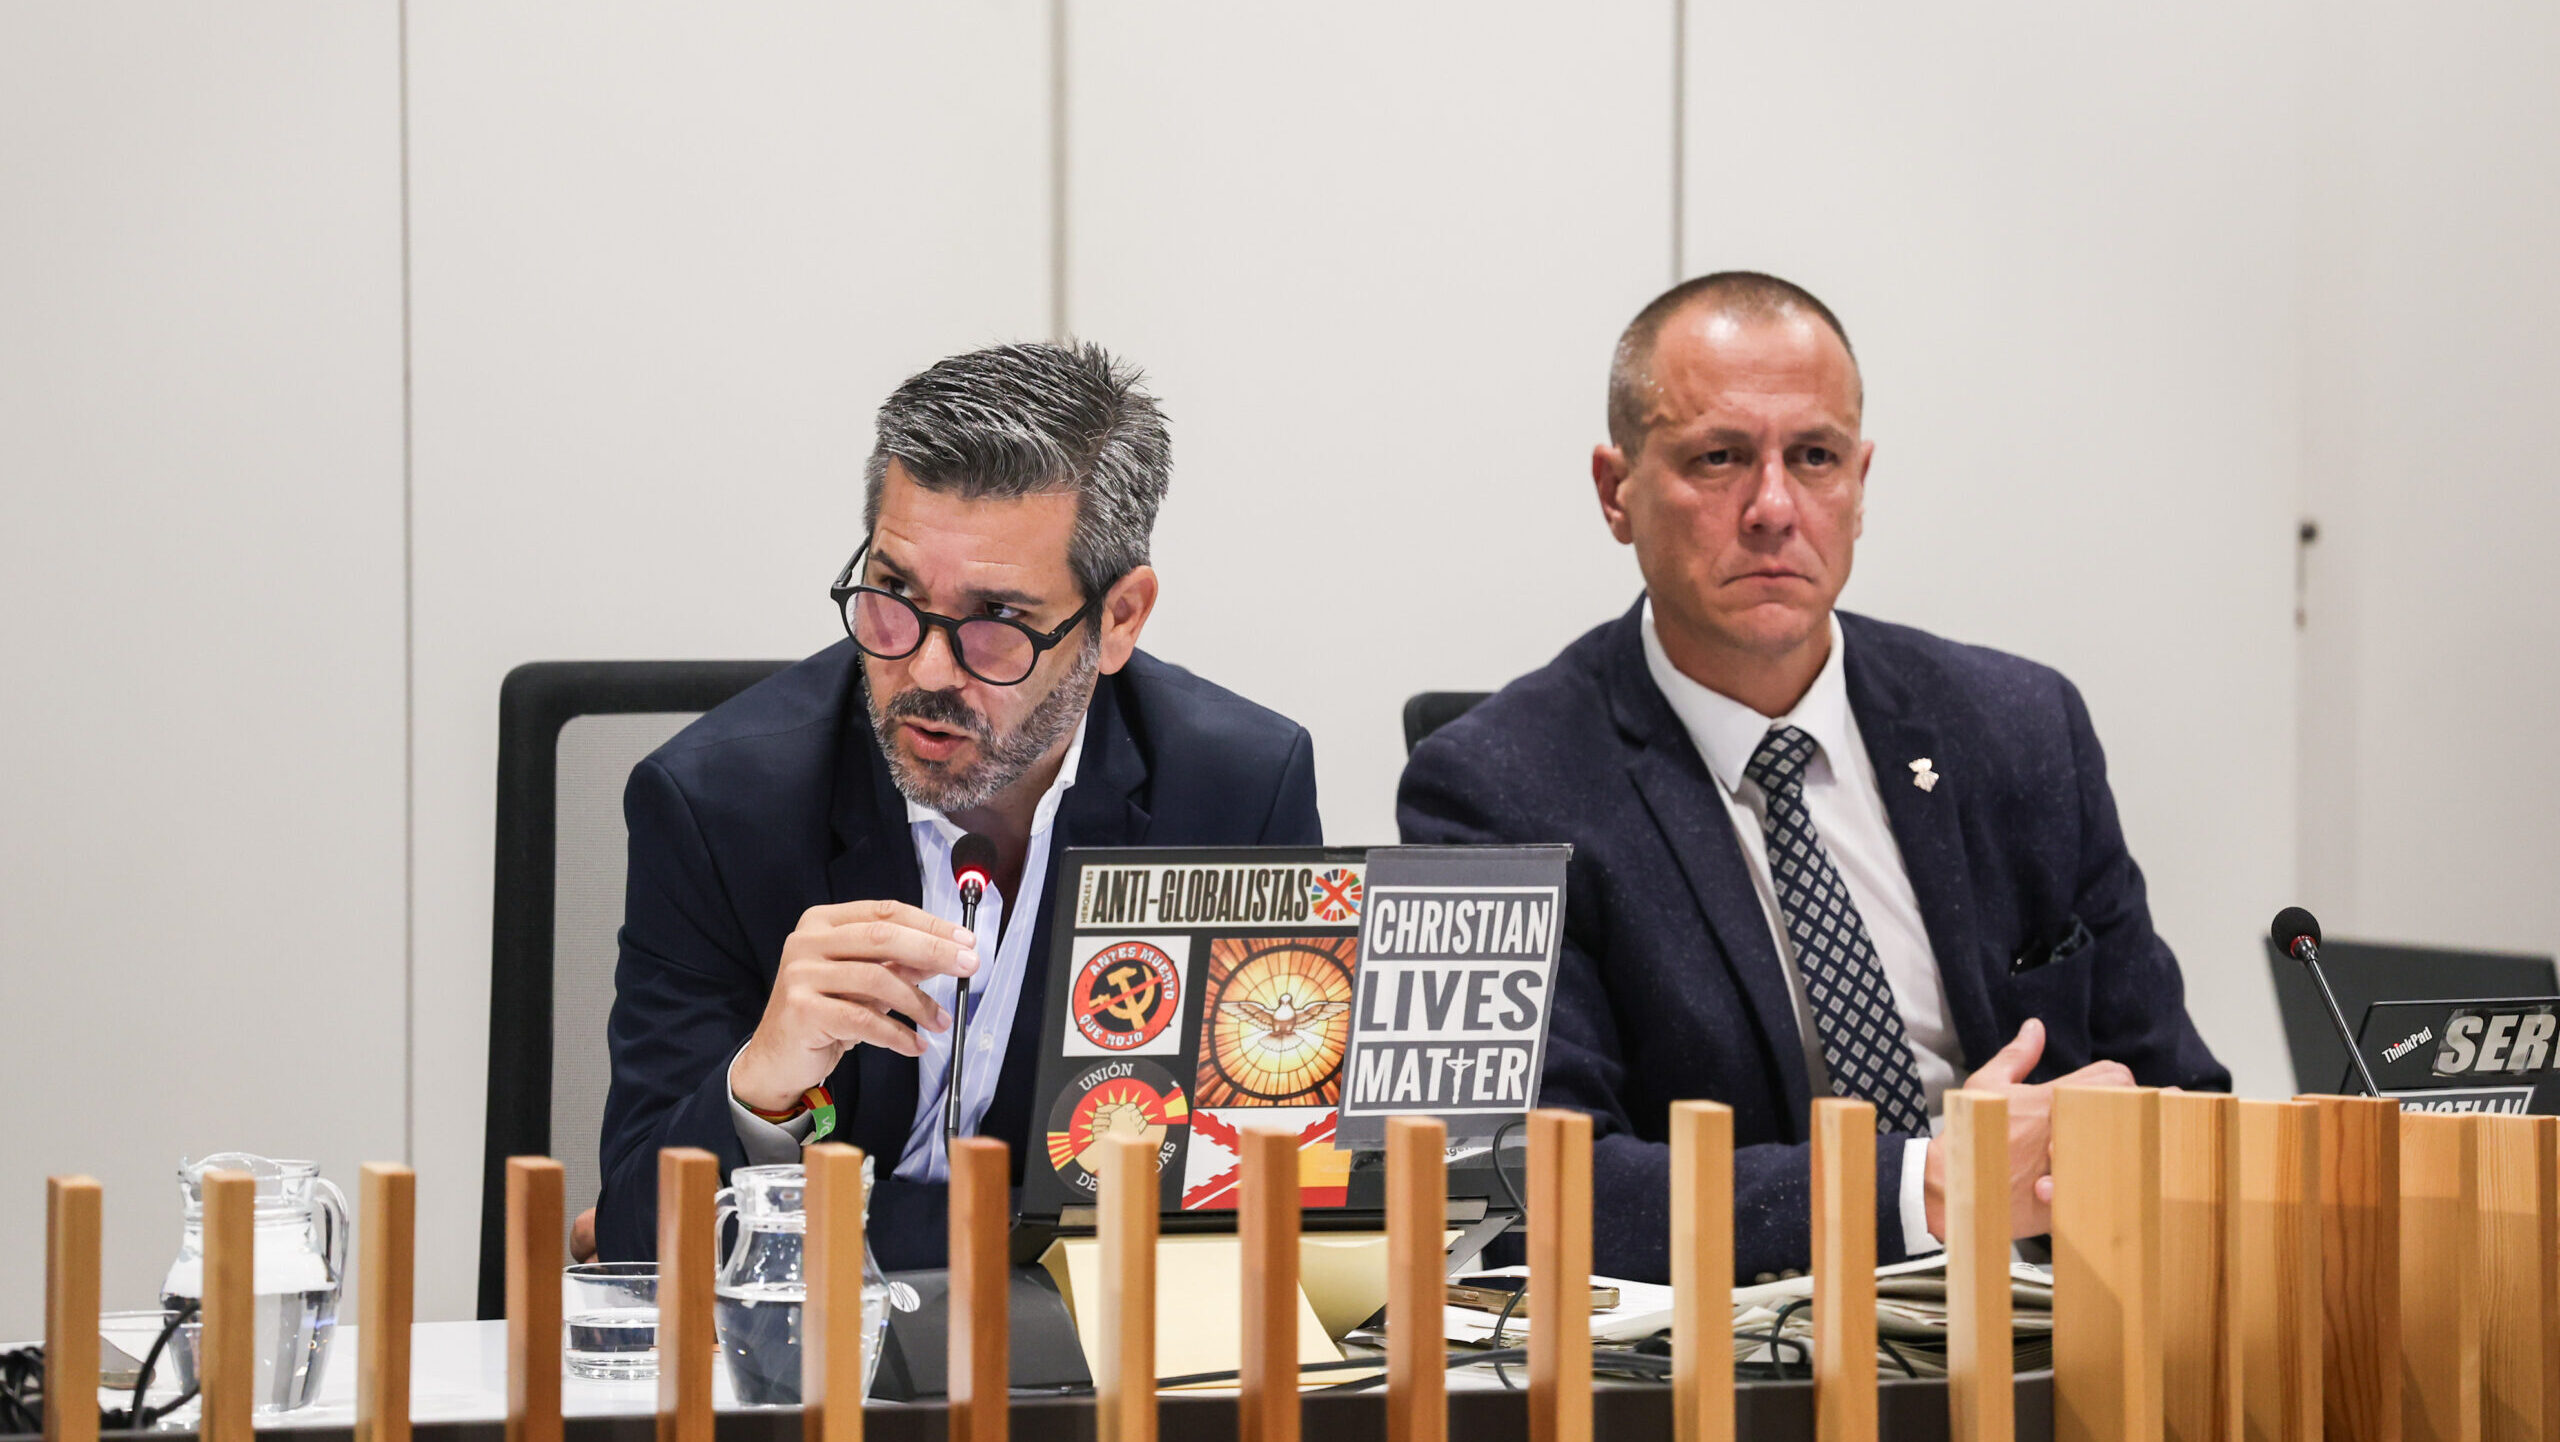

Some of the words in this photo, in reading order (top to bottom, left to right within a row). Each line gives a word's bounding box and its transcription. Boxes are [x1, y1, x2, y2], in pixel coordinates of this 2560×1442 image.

[1091, 869, 1312, 923] ANTI-GLOBALISTAS
[1372, 899, 1550, 955] CHRISTIAN
[1088, 946, 1137, 977] ANTES
[1140, 947, 1175, 1000] MUERTO
[1359, 969, 1543, 1032] LIVES
[1079, 1013, 1104, 1040] QUE
[1105, 1030, 1144, 1047] ROJO
[2381, 1025, 2433, 1064] ThinkPad
[2437, 1013, 2560, 1074] SER
[1078, 1060, 1134, 1091] UNIÓN
